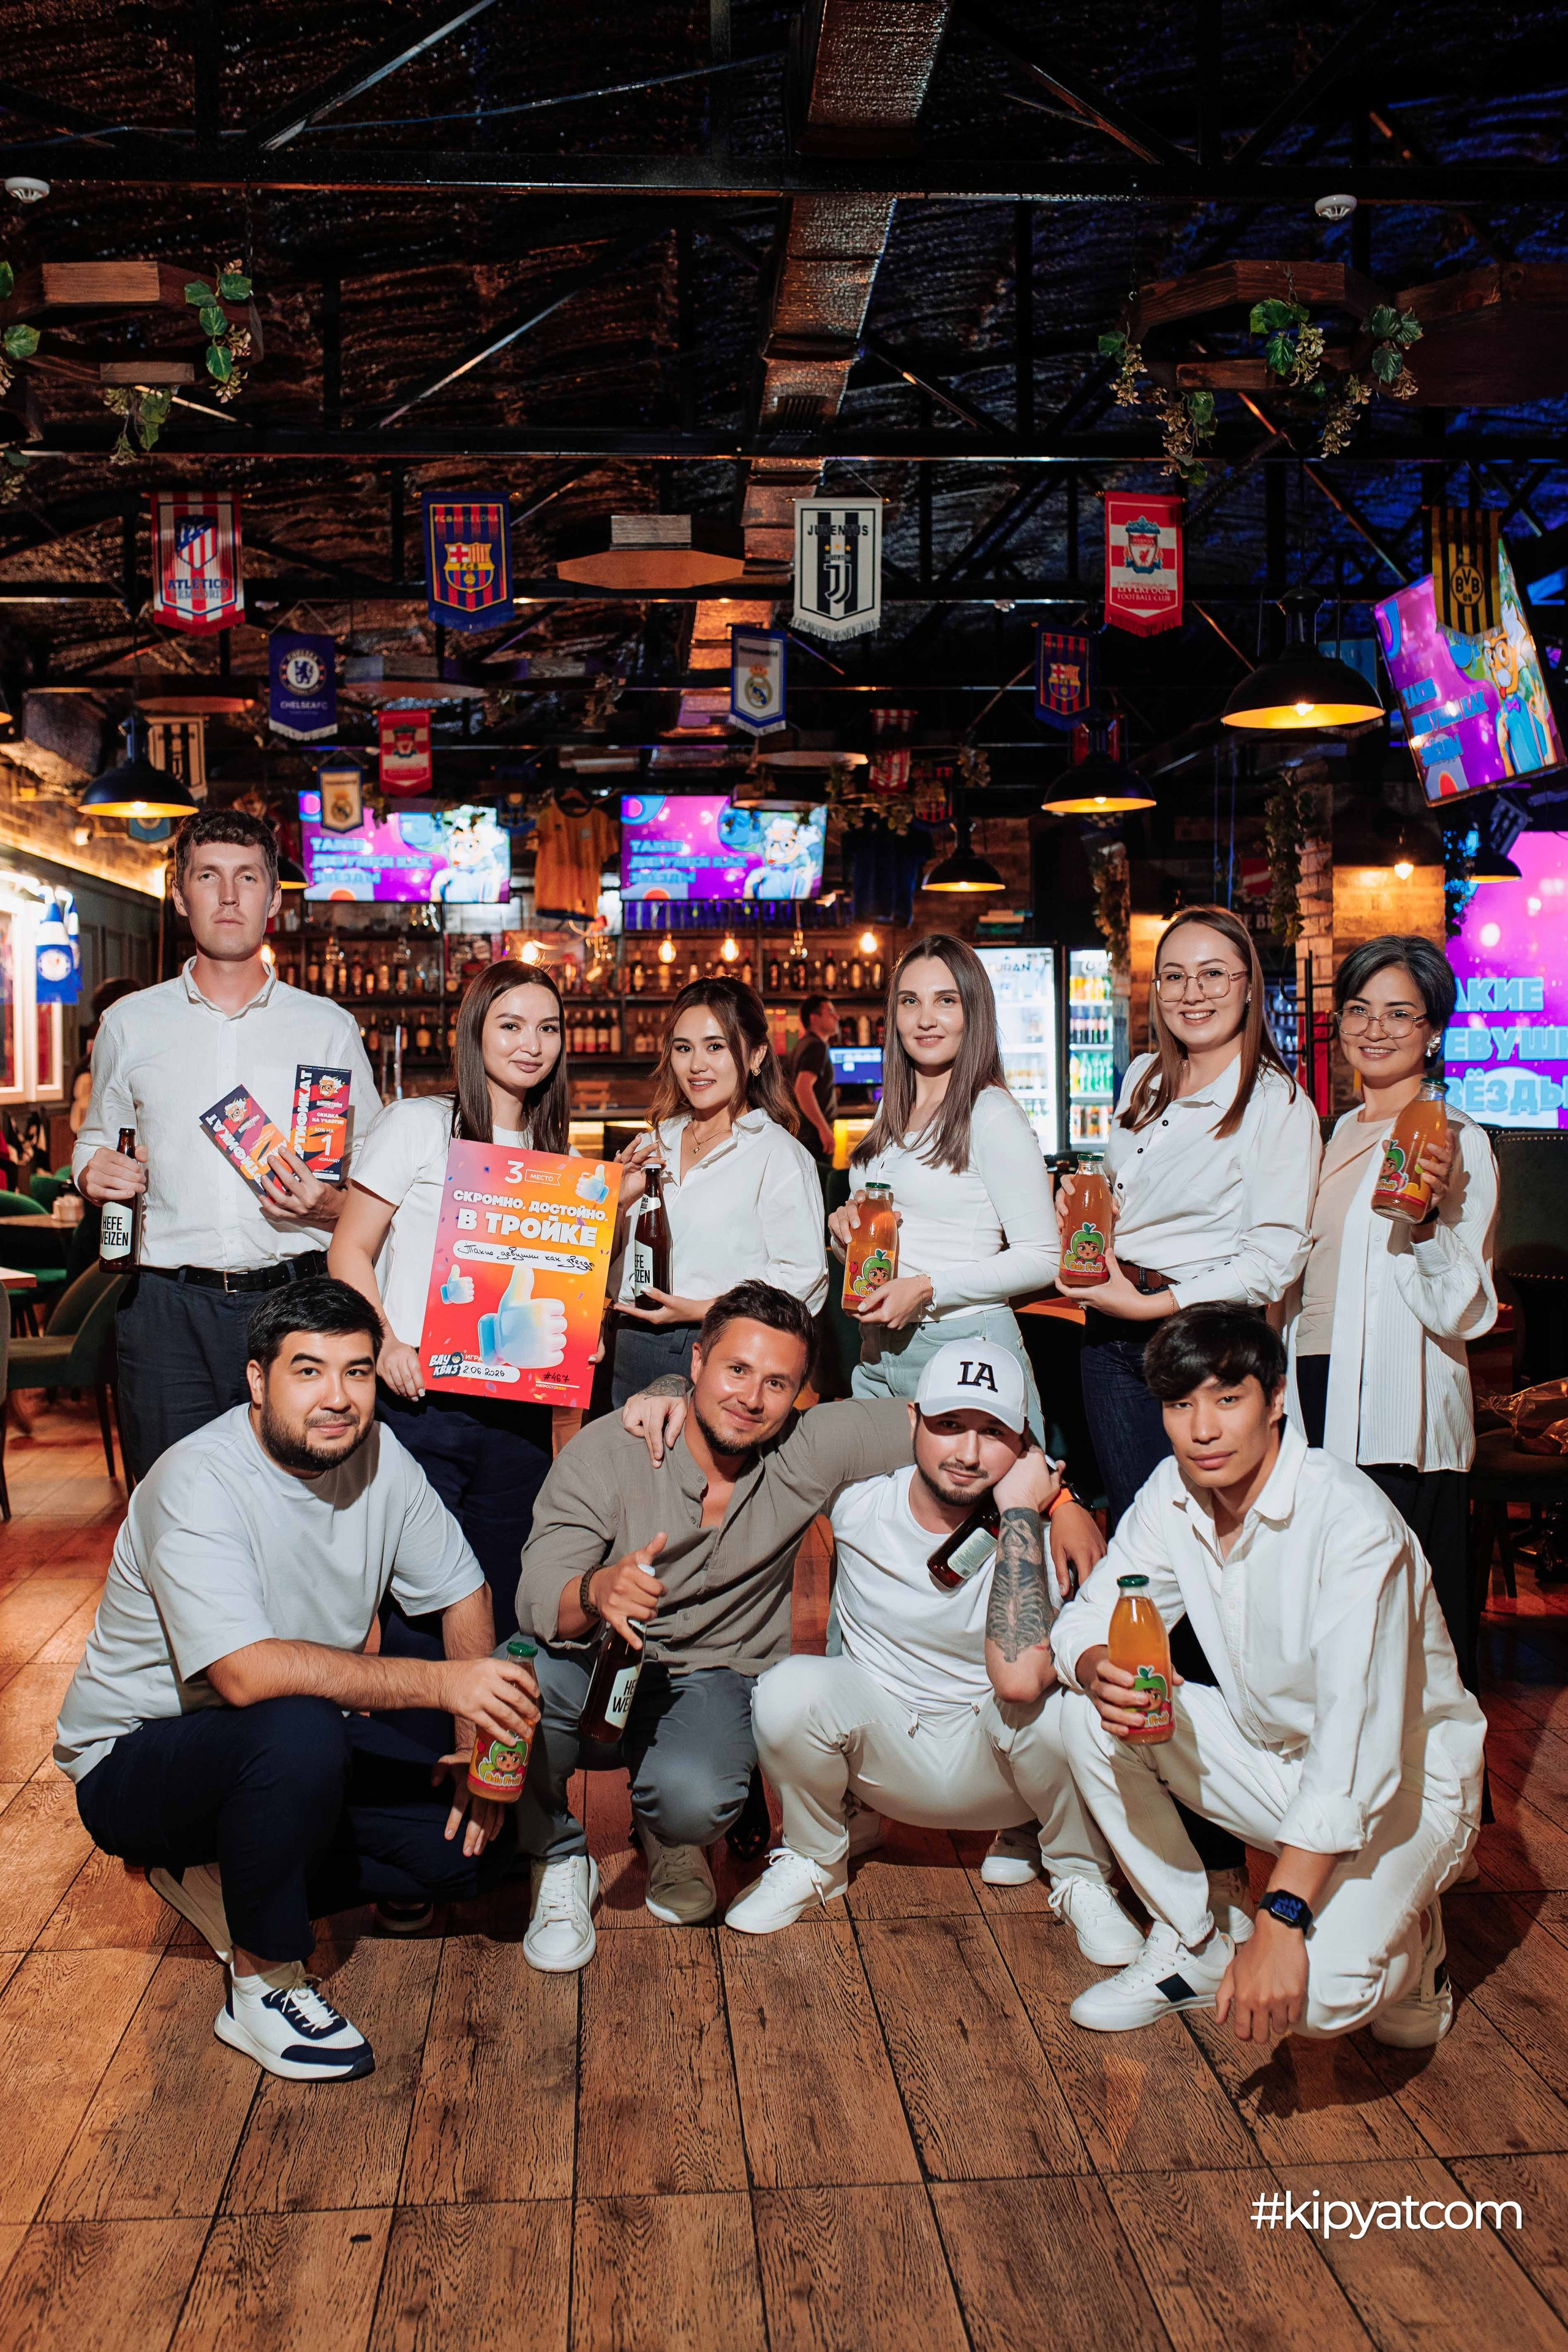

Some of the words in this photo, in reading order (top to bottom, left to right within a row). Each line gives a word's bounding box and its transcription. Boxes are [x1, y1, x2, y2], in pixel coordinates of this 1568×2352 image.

[807, 525, 869, 536] JUVENTUS
[1117, 581, 1170, 595] LIVERPOOL
[321, 1135, 332, 1156] 1
[504, 1160, 524, 1184] 3
[453, 1189, 526, 1210] СКРОМНО.
[529, 1200, 608, 1221] ДОСТОЙНО.
[102, 1215, 123, 1231] HEFE
[457, 1208, 478, 1231] В
[485, 1212, 598, 1247] ТРОЙКЕ
[429, 1354, 451, 1367] ВАУ
[433, 1364, 459, 1376] КВИЗ
[543, 1371, 570, 1383] #467
